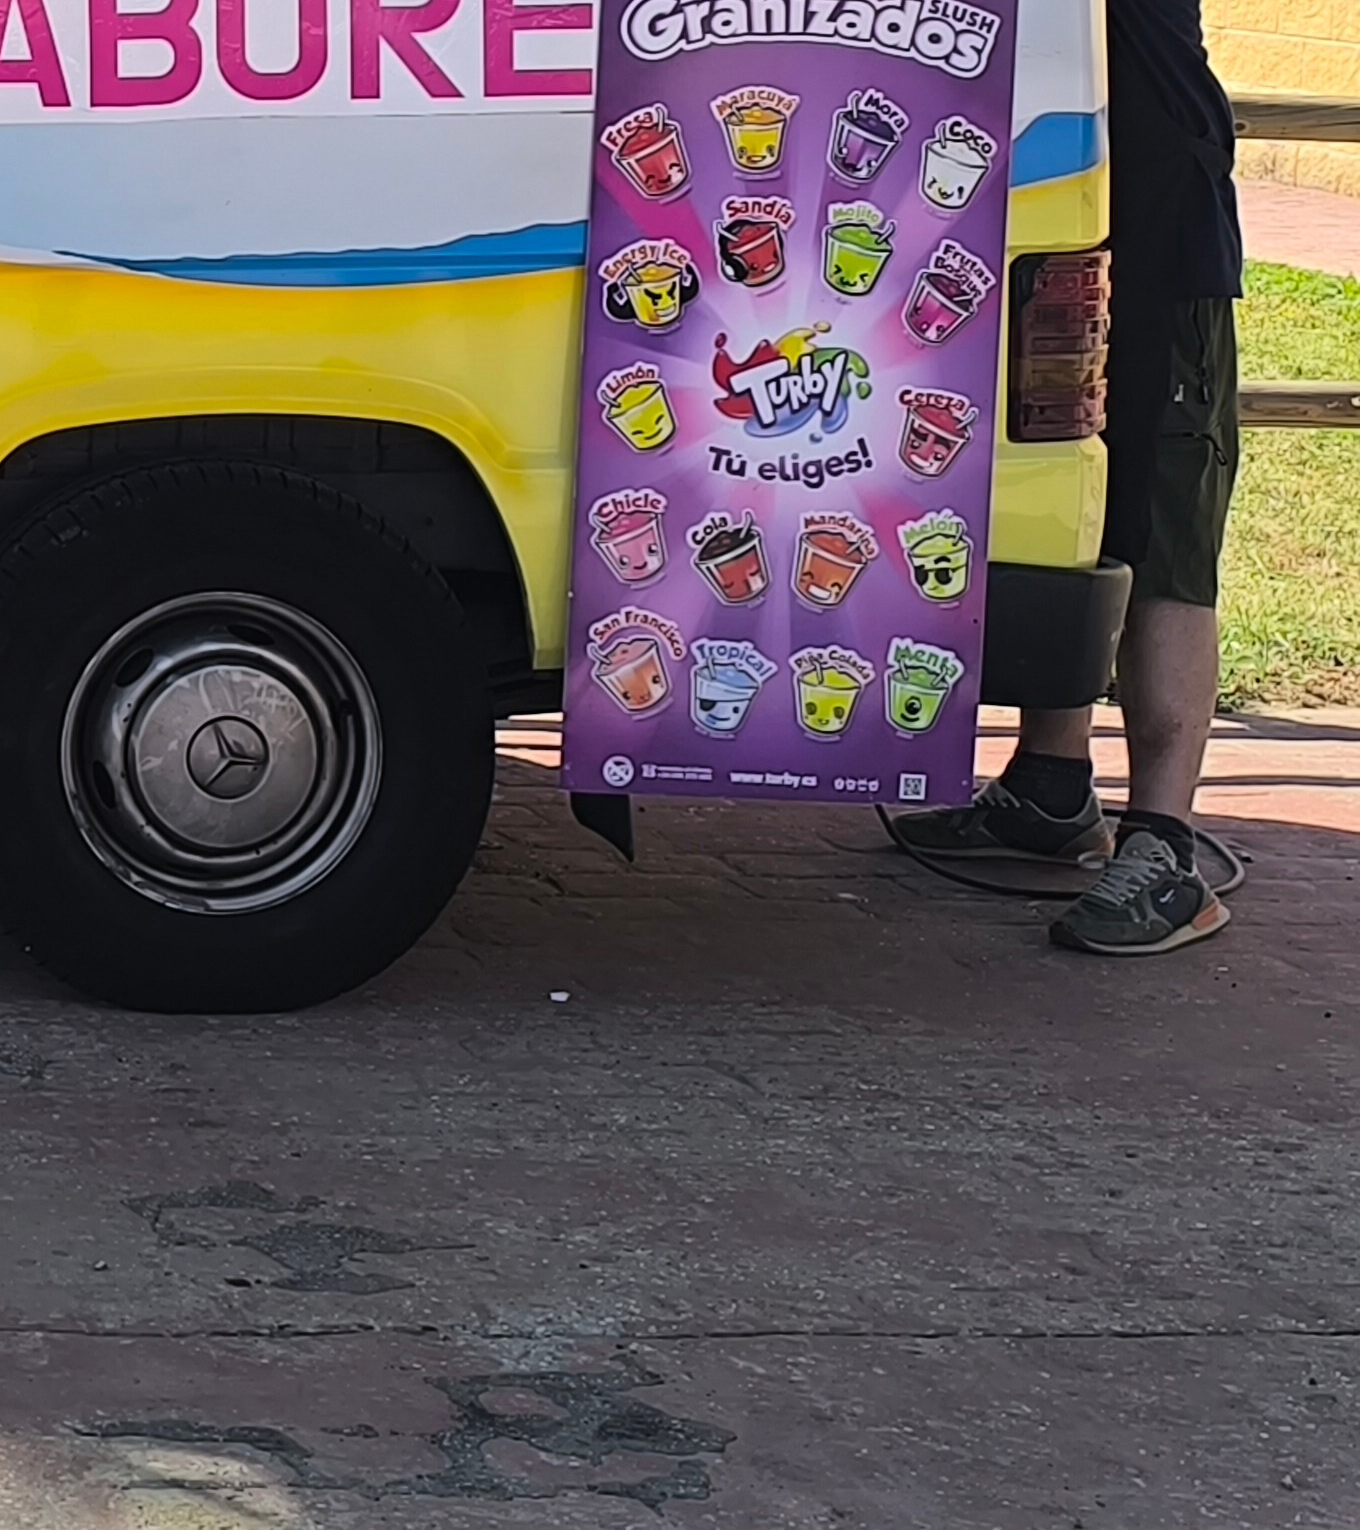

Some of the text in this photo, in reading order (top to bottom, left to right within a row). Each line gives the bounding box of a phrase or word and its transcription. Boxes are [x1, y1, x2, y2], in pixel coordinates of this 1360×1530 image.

[716, 88, 795, 117] Maracuyá
[864, 93, 907, 130] Mora
[605, 110, 655, 149] Fresa
[948, 120, 994, 156] Coco
[725, 199, 793, 226] Sandía
[603, 241, 688, 279] Energy Ice
[607, 366, 656, 396] Limón
[898, 389, 966, 412] Cereza
[708, 436, 875, 489] Tú eliges!
[597, 493, 662, 519] Chicle
[691, 515, 729, 546] Cola
[593, 610, 684, 658] San Francisco
[695, 643, 773, 678] Tropical
[893, 644, 959, 679] Menta
